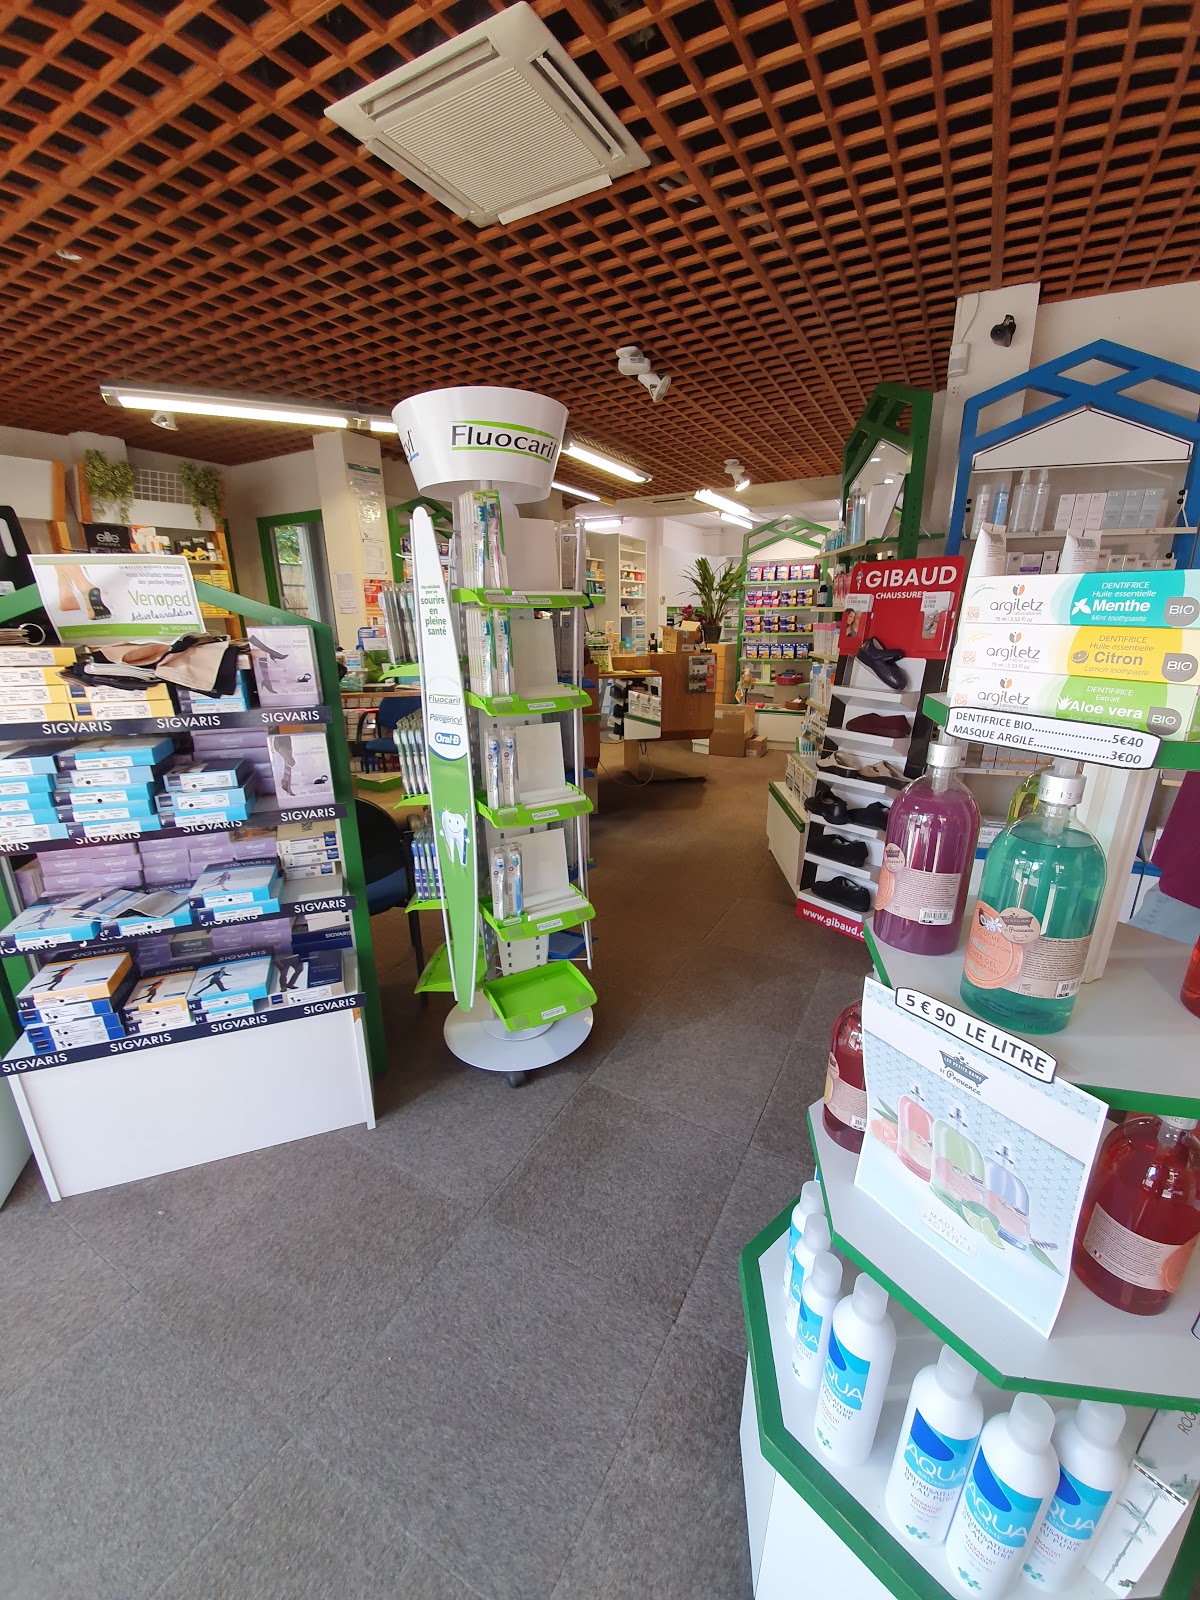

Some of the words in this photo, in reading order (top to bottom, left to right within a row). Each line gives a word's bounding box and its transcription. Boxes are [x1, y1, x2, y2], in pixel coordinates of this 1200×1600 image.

[451, 424, 557, 460] Fluocaril
[865, 566, 957, 589] GIBAUD
[1102, 581, 1151, 589] DENTIFRICE
[127, 590, 191, 609] Venoped
[420, 595, 445, 605] sourire
[1092, 599, 1151, 612] Menthe
[989, 599, 1044, 616] argiletz
[1168, 604, 1195, 615] BIO
[425, 616, 447, 628] pleine
[1107, 615, 1147, 623] toothpaste
[427, 626, 447, 636] santé
[1098, 634, 1149, 644] DENTIFRICE
[986, 646, 1041, 662] argiletz
[1089, 642, 1111, 650] Huile
[1112, 643, 1155, 652] essentielle
[1093, 650, 1144, 666] Citron
[1084, 665, 1109, 673] Lemon
[1110, 667, 1149, 676] toothpaste
[1166, 661, 1193, 671] BIO
[977, 691, 1030, 706] argiletz
[1086, 685, 1134, 697] DENTIFRICE
[1095, 695, 1120, 703] Extrait
[1069, 700, 1104, 715] Aloe
[1108, 706, 1143, 719] vera
[156, 715, 221, 729] SIGVARIS
[261, 711, 321, 724] SIGVARIS
[1151, 714, 1177, 726] BIO
[42, 720, 113, 735] SIGVARIS
[956, 711, 1012, 728] DENTIFRICE
[1013, 720, 1033, 731] BIO
[1111, 733, 1144, 748] 5€40
[435, 733, 460, 745] Oral-B
[953, 724, 995, 740] MASQUE
[997, 731, 1035, 746] ARGILE
[1109, 750, 1142, 765] 3€00
[280, 807, 336, 822] SIGVARIS
[293, 899, 347, 914] SIGVARIS
[218, 949, 267, 963] SIGVARIS
[303, 997, 357, 1016] SIGVARIS
[210, 1014, 269, 1034] SIGVARIS
[905, 994, 916, 1007] 5
[920, 1001, 932, 1015] €
[934, 1007, 956, 1027] 90
[965, 1022, 987, 1044] LE
[990, 1034, 1047, 1074] LITRE
[109, 1033, 173, 1053] SIGVARIS
[2, 1053, 68, 1074] SIGVARIS
[946, 1069, 982, 1096] Provence
[826, 1358, 863, 1403] QUA
[1177, 1410, 1197, 1436] ROG
[906, 1443, 967, 1482] AQUA
[967, 1481, 1028, 1539] AQUA
[1049, 1498, 1096, 1533] QUA
